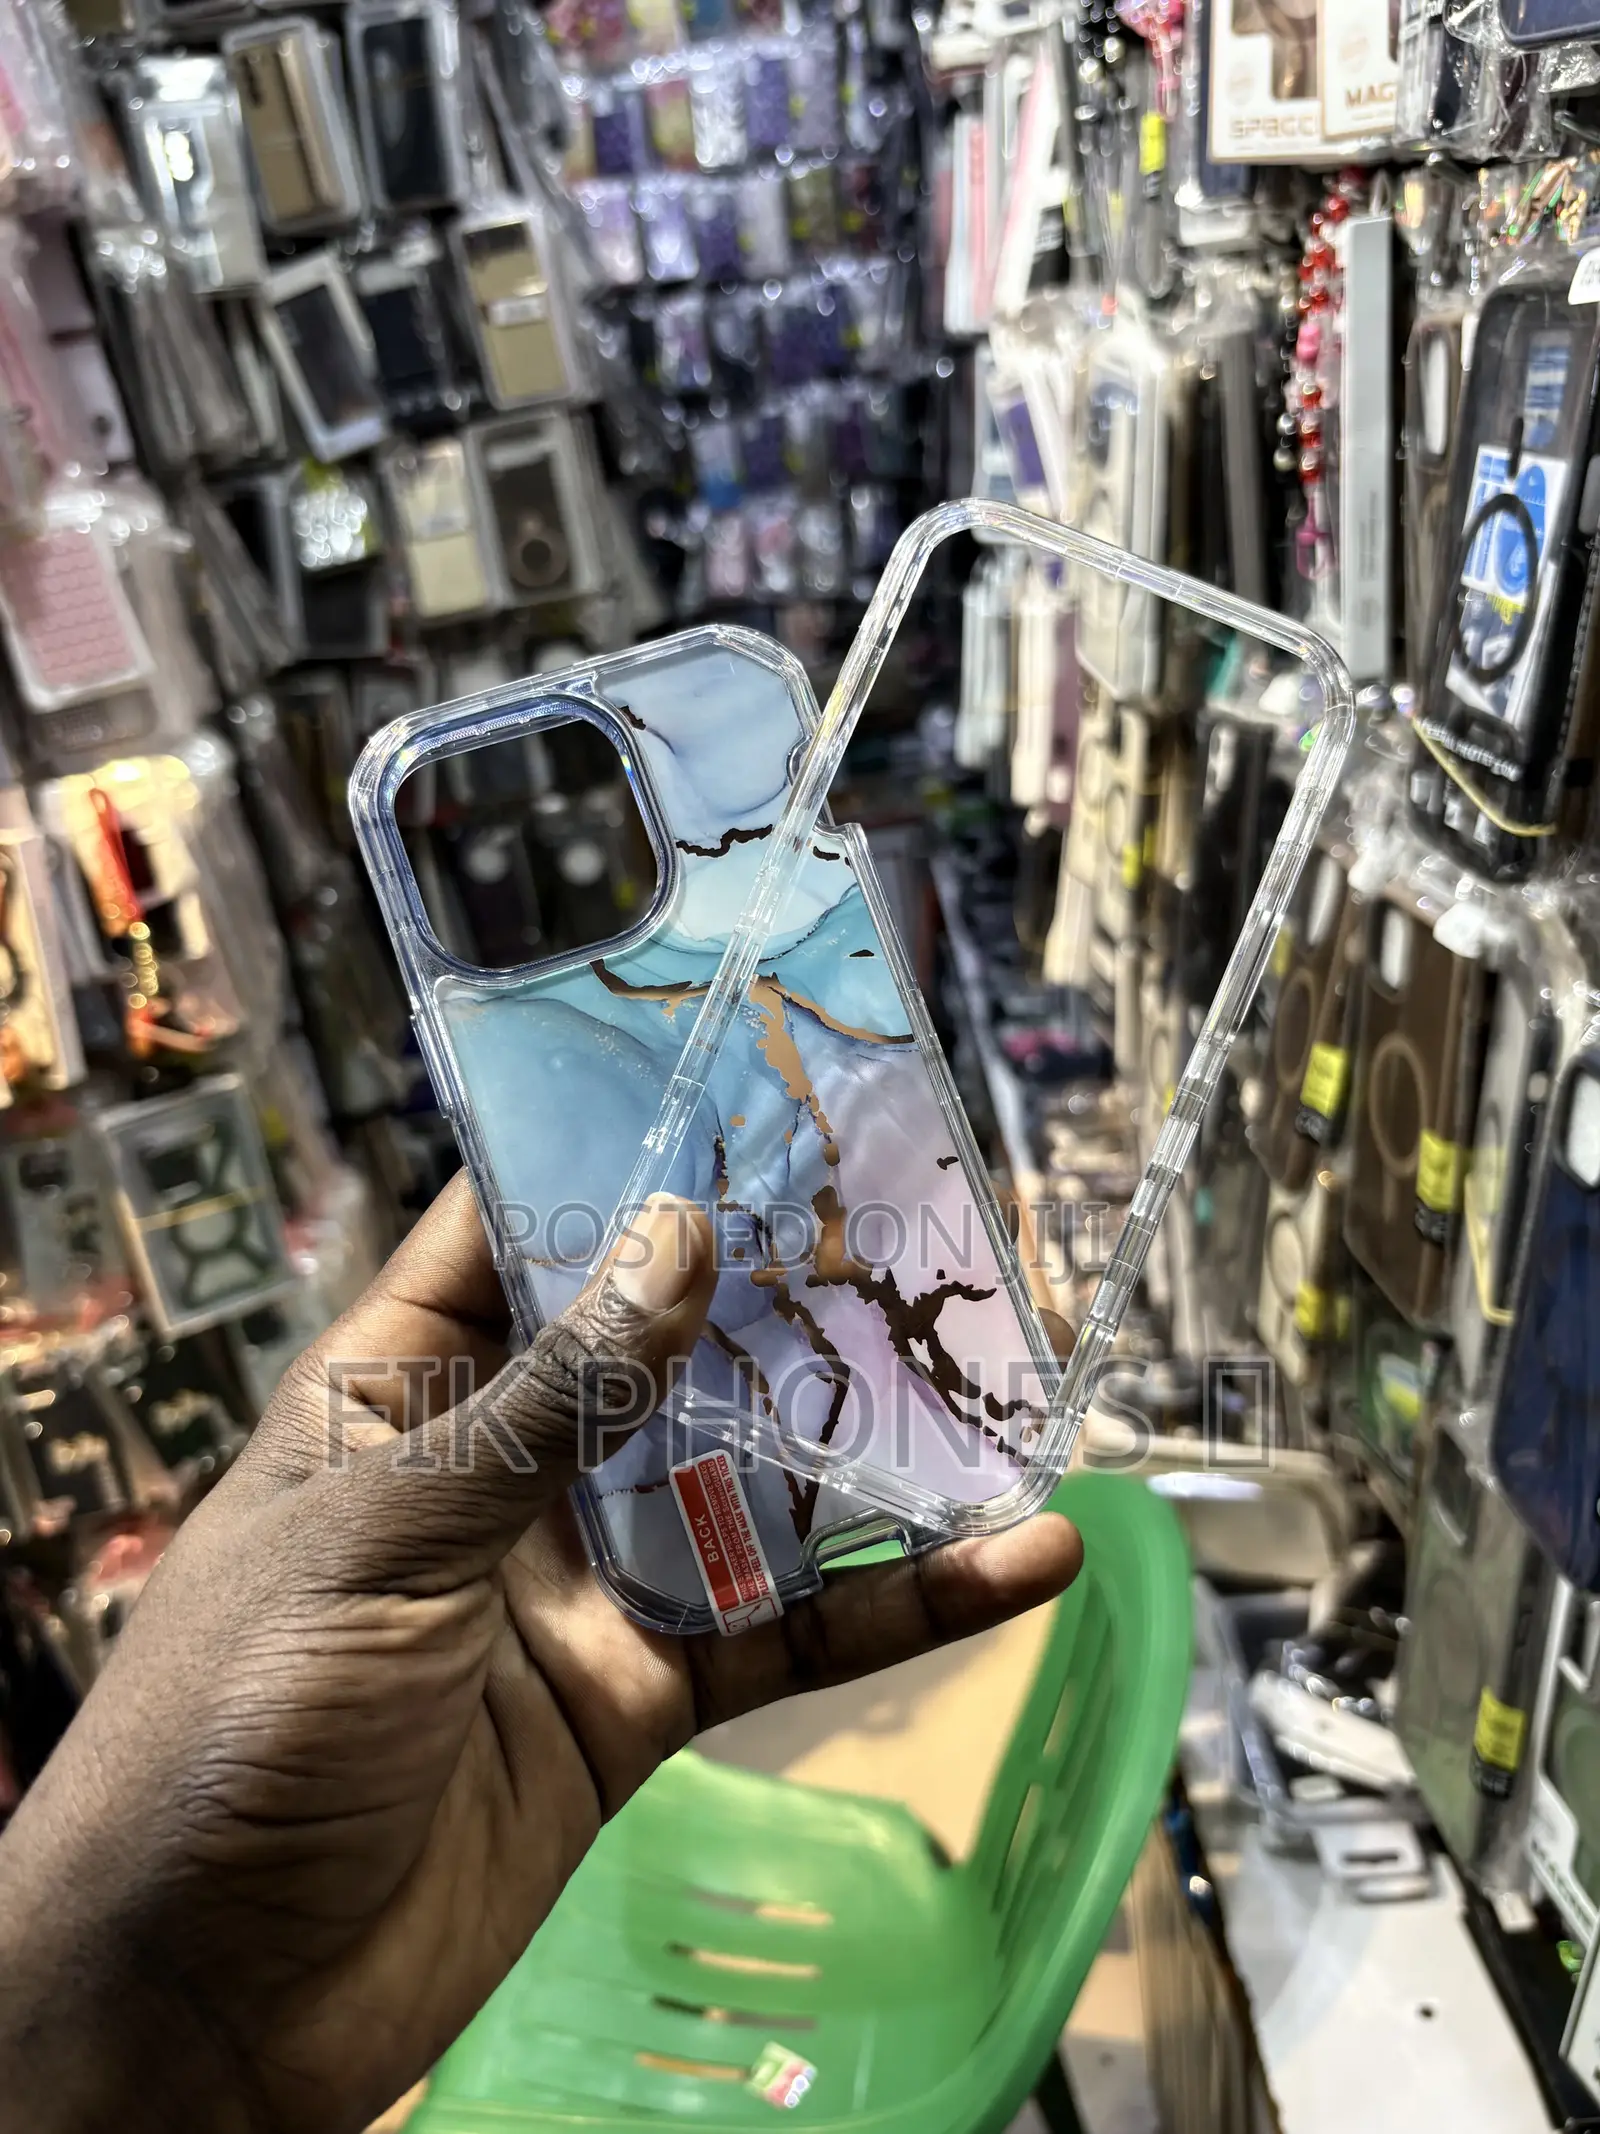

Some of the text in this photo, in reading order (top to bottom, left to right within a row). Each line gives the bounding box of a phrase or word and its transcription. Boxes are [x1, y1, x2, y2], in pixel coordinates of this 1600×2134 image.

[706, 1484, 722, 1516] REMOVE
[725, 1513, 736, 1530] THE
[694, 1514, 720, 1563] BACK
[731, 1531, 744, 1554] FROM
[728, 1551, 745, 1582] STICKER
[739, 1556, 753, 1580] MASK
[739, 1583, 751, 1600] THIS
[747, 1580, 759, 1597] THE
[755, 1572, 771, 1596] PLEASE
